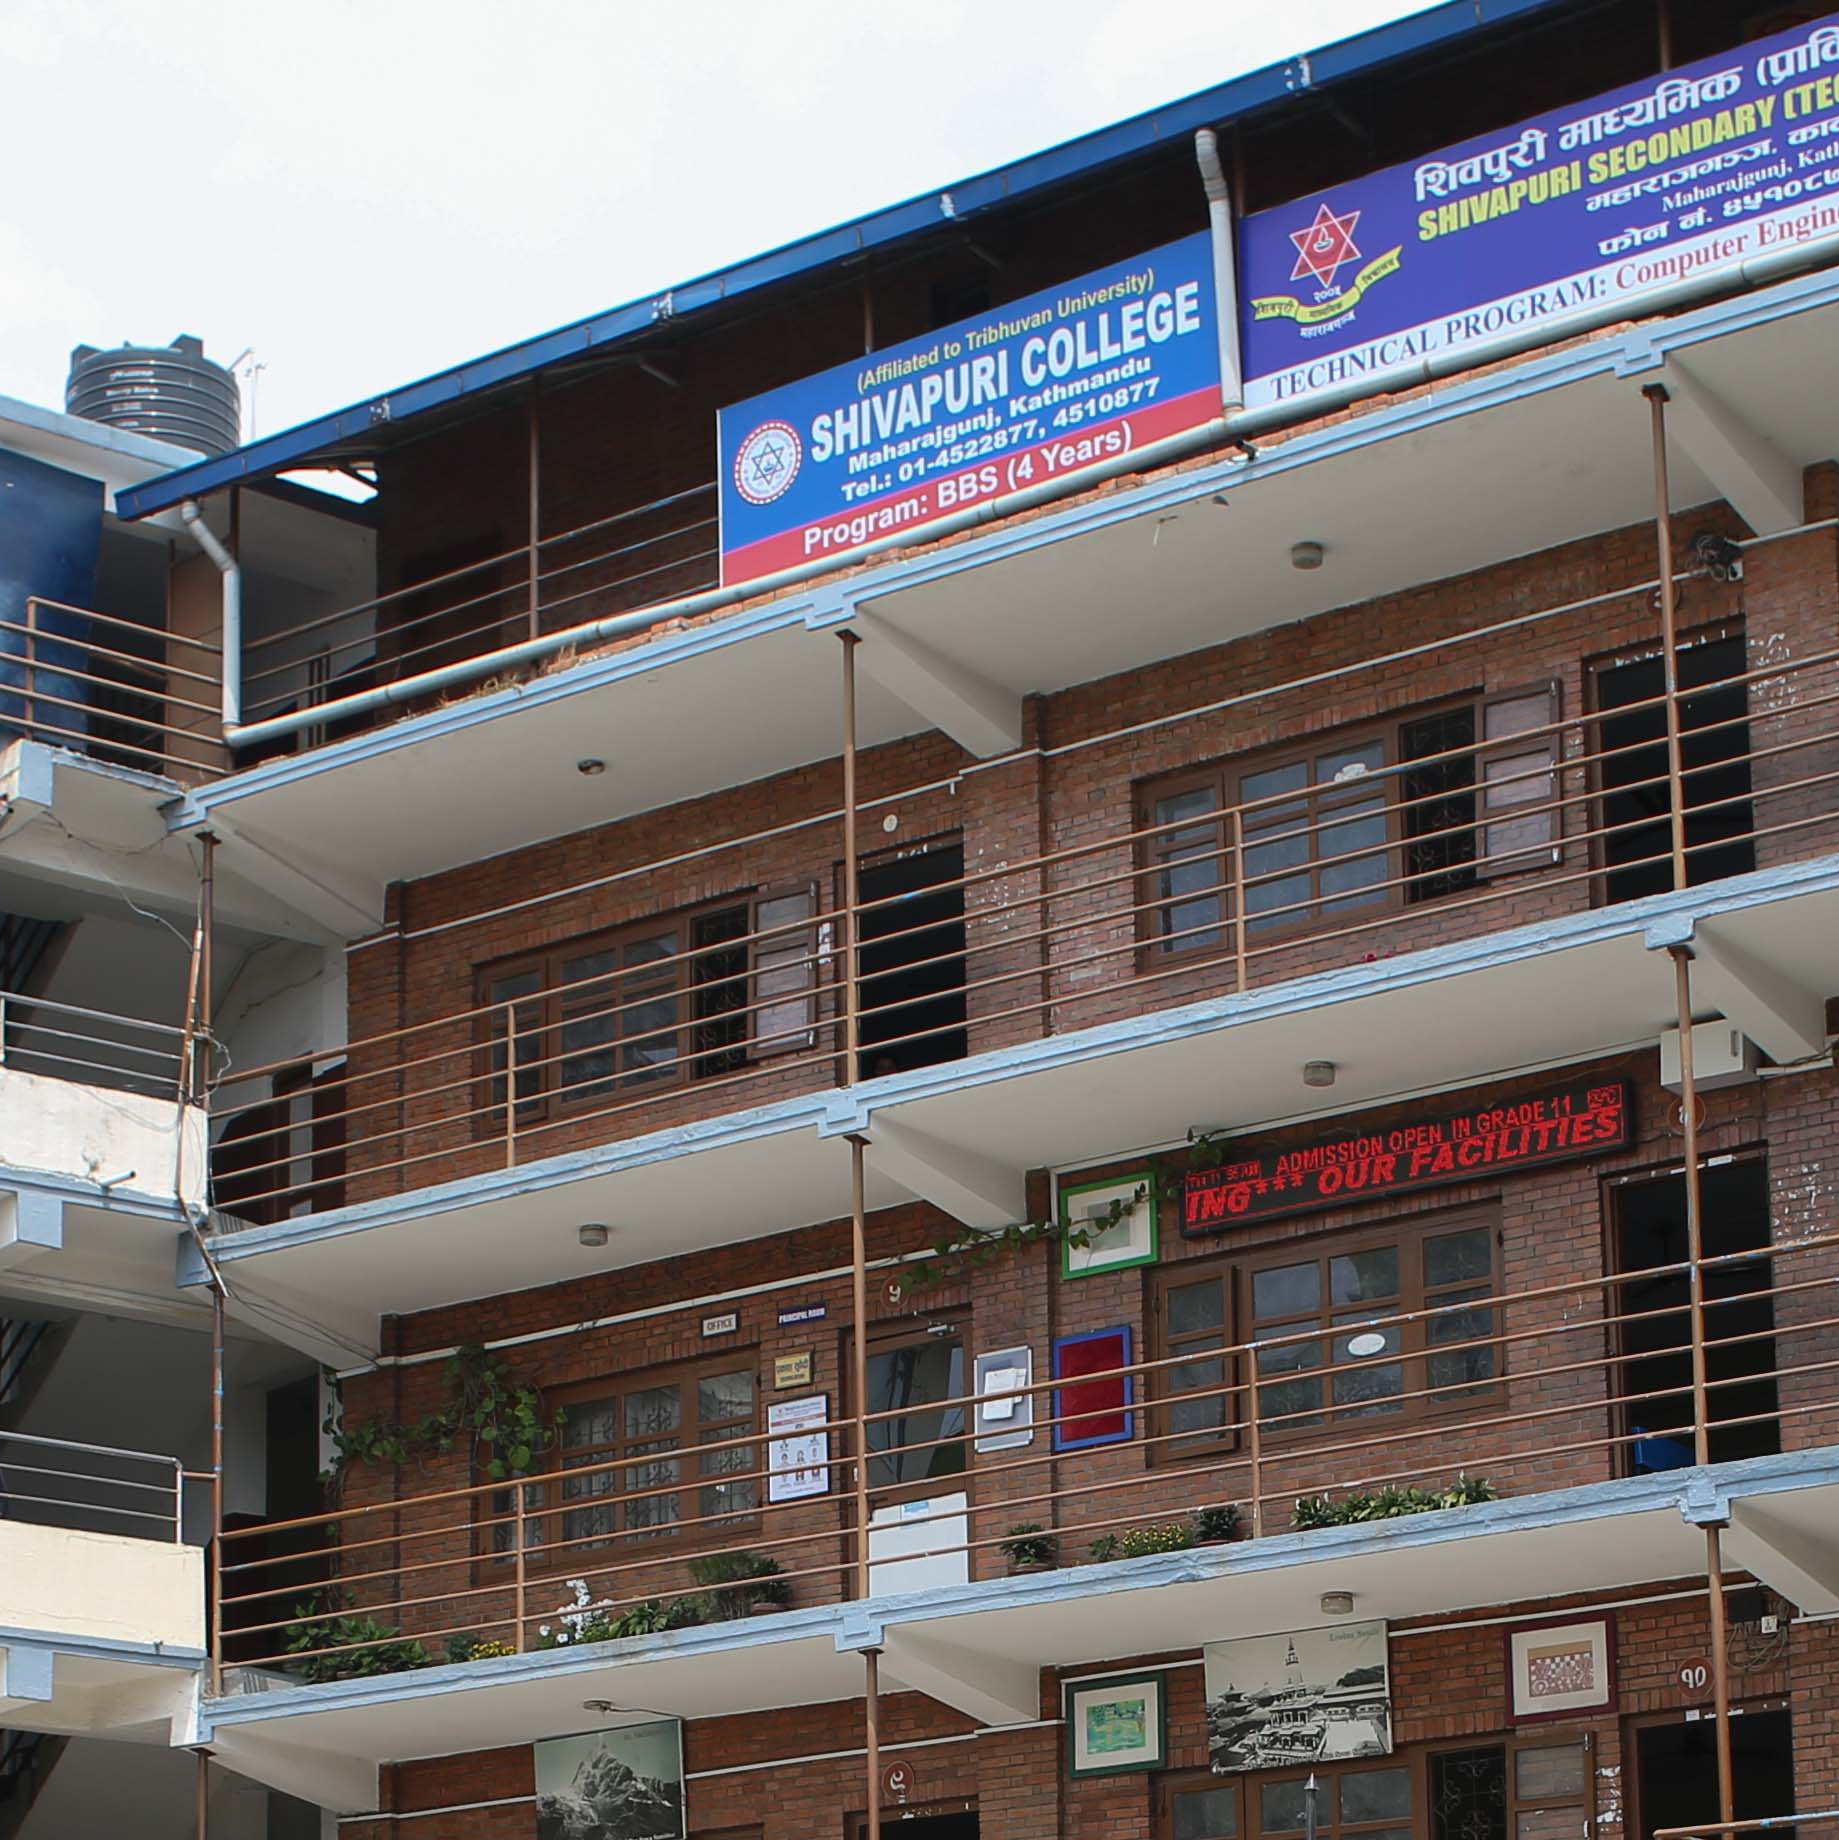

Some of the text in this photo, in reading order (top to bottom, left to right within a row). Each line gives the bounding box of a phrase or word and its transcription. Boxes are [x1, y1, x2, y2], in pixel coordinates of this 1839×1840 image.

[1414, 129, 1548, 201] शिवपुरी
[1559, 66, 1744, 150] माध्यमिक
[1418, 161, 1581, 241] SHIVAPURI
[1588, 95, 1776, 185] SECONDARY
[1662, 159, 1792, 213] Maharajgunj,
[1599, 221, 1670, 255] फोन
[811, 350, 1009, 463] SHIVAPURI
[1021, 281, 1201, 387] COLLEGE
[857, 267, 1155, 394] (Affiliated to Tribhuvan University)
[1270, 329, 1438, 401] TECHNICAL
[1445, 274, 1608, 353] PROGRAM:
[1616, 233, 1749, 290] Computer
[842, 376, 1160, 502] Tel.: 01-4522877, 4510877
[848, 407, 1002, 475] Maharajgunj,
[1009, 356, 1152, 419] Kathmandu
[804, 421, 1134, 555] Program: BBS (4 Years)
[1276, 1136, 1382, 1175] ADMISSION
[1389, 1124, 1442, 1151] OPEN
[1453, 1117, 1470, 1140] IN
[1477, 1101, 1544, 1133] GRADE
[1551, 1096, 1571, 1118] 11
[1318, 1156, 1396, 1194] OUR
[1410, 1108, 1618, 1176] FACILITIES
[1681, 1666, 1706, 1688] १०
